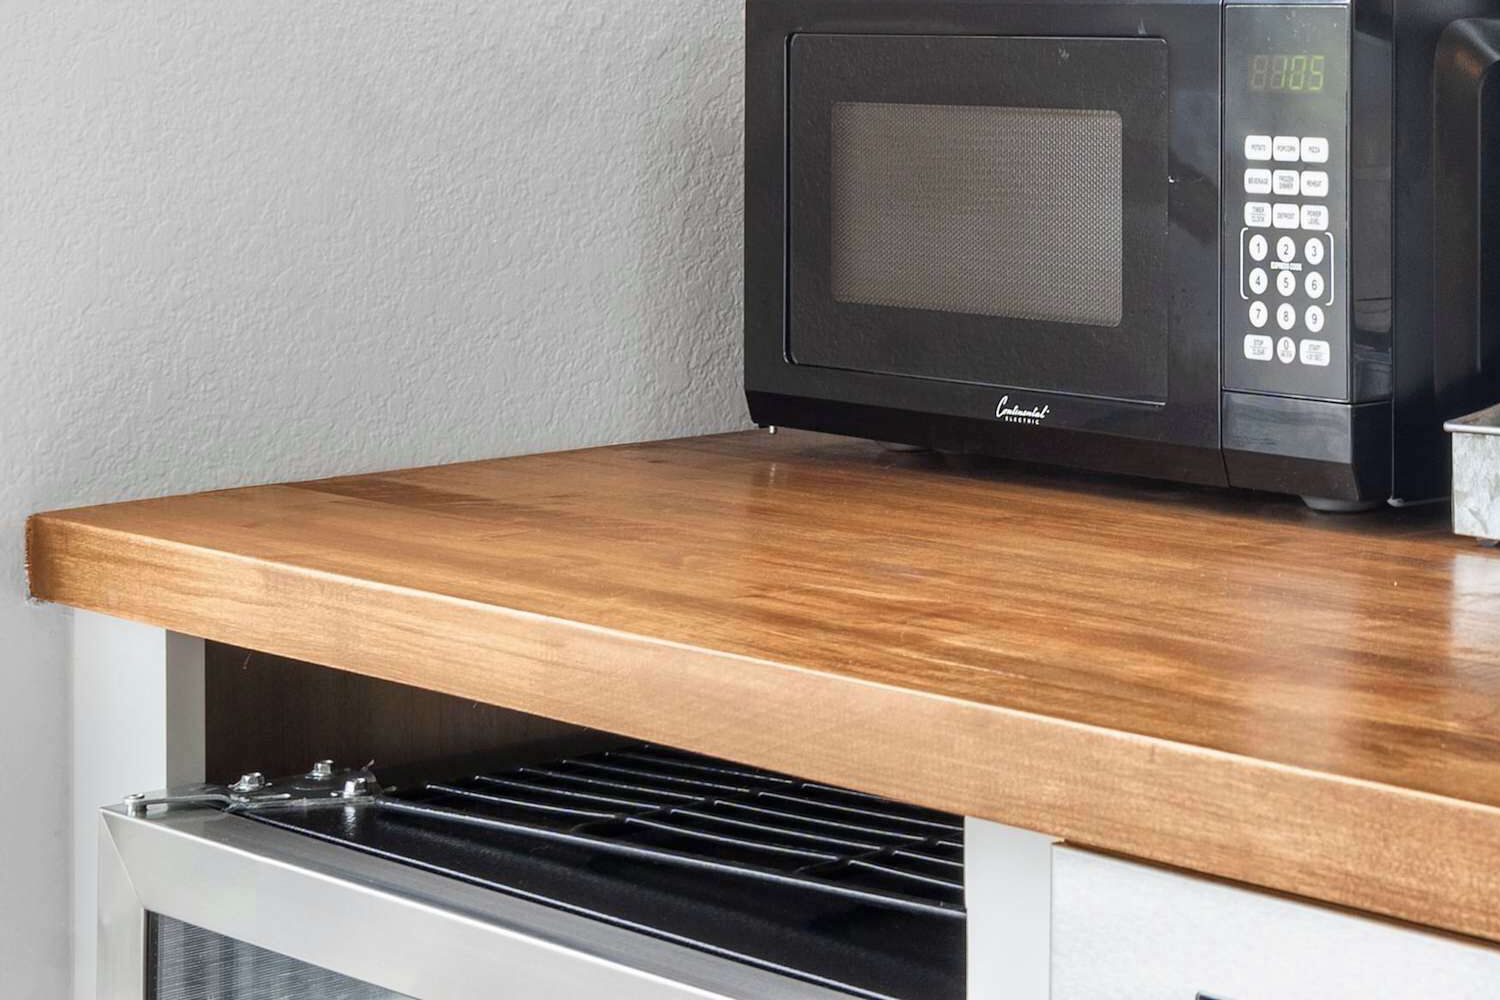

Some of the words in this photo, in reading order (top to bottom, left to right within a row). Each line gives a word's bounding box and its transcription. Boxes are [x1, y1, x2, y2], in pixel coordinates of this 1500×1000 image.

[1283, 243, 1289, 255] 2
[1311, 245, 1317, 257] 3
[1255, 276, 1261, 286] 4
[1283, 277, 1289, 289] 5
[1311, 279, 1318, 291] 6
[1255, 308, 1262, 319] 7
[1283, 310, 1289, 322] 8
[1311, 313, 1318, 325] 9
[1283, 339, 1289, 350] 0
[995, 395, 1049, 418] Continental
[1005, 415, 1040, 425] ELECTRIC
